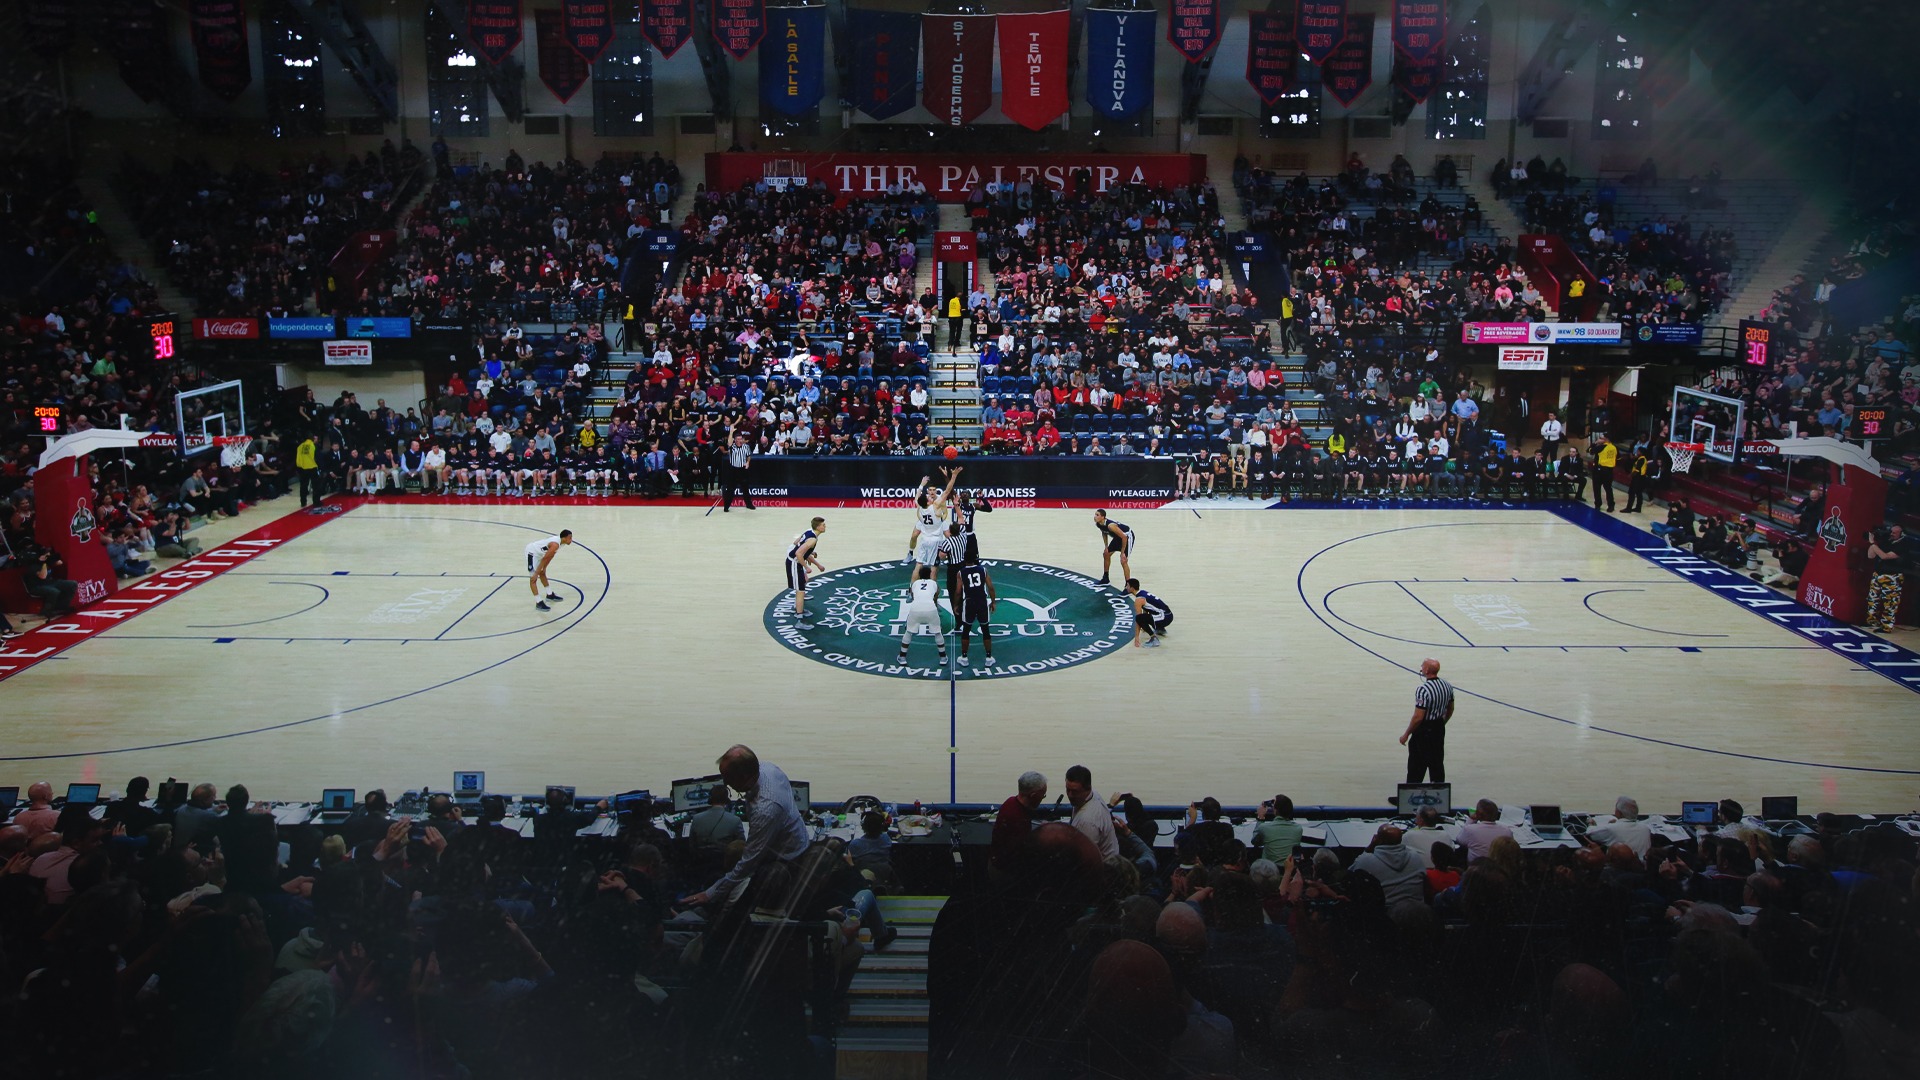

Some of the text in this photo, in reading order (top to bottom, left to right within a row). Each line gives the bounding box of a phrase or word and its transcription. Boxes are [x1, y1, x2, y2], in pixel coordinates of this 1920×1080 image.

[1308, 34, 1332, 47] 1975
[786, 18, 799, 96] LA SALLE
[1027, 32, 1042, 97] TEMPLE
[1111, 15, 1128, 111] VILLANOVA
[873, 32, 892, 103] PENN
[951, 53, 964, 126] JOSEPHS
[834, 165, 917, 192] THE
[151, 321, 173, 337] 20:00
[270, 323, 323, 332] Independence
[1745, 327, 1769, 342] 20:00
[154, 335, 175, 360] 30
[327, 345, 369, 356] ESPN
[1502, 349, 1545, 361] ESPN
[1746, 341, 1767, 366] 30
[34, 407, 60, 417] 20:00
[1859, 410, 1885, 420] 20:00
[41, 417, 56, 431] 30
[1863, 421, 1879, 434] 30
[1108, 489, 1170, 498] IVYLEAGUE.TV
[922, 514, 934, 525] 25
[843, 562, 896, 575] YALE
[1634, 547, 1732, 577] THE
[35, 538, 282, 635] PALESTRA
[85, 578, 106, 597] IVY
[967, 572, 981, 588] 13
[1018, 564, 1108, 593] COLUMBIA
[1812, 591, 1835, 610] IVY
[1107, 597, 1134, 634] CORNELL
[775, 624, 816, 650] PENN
[824, 652, 943, 677] HARVARD
[972, 639, 1115, 677] DARTMOUTH
